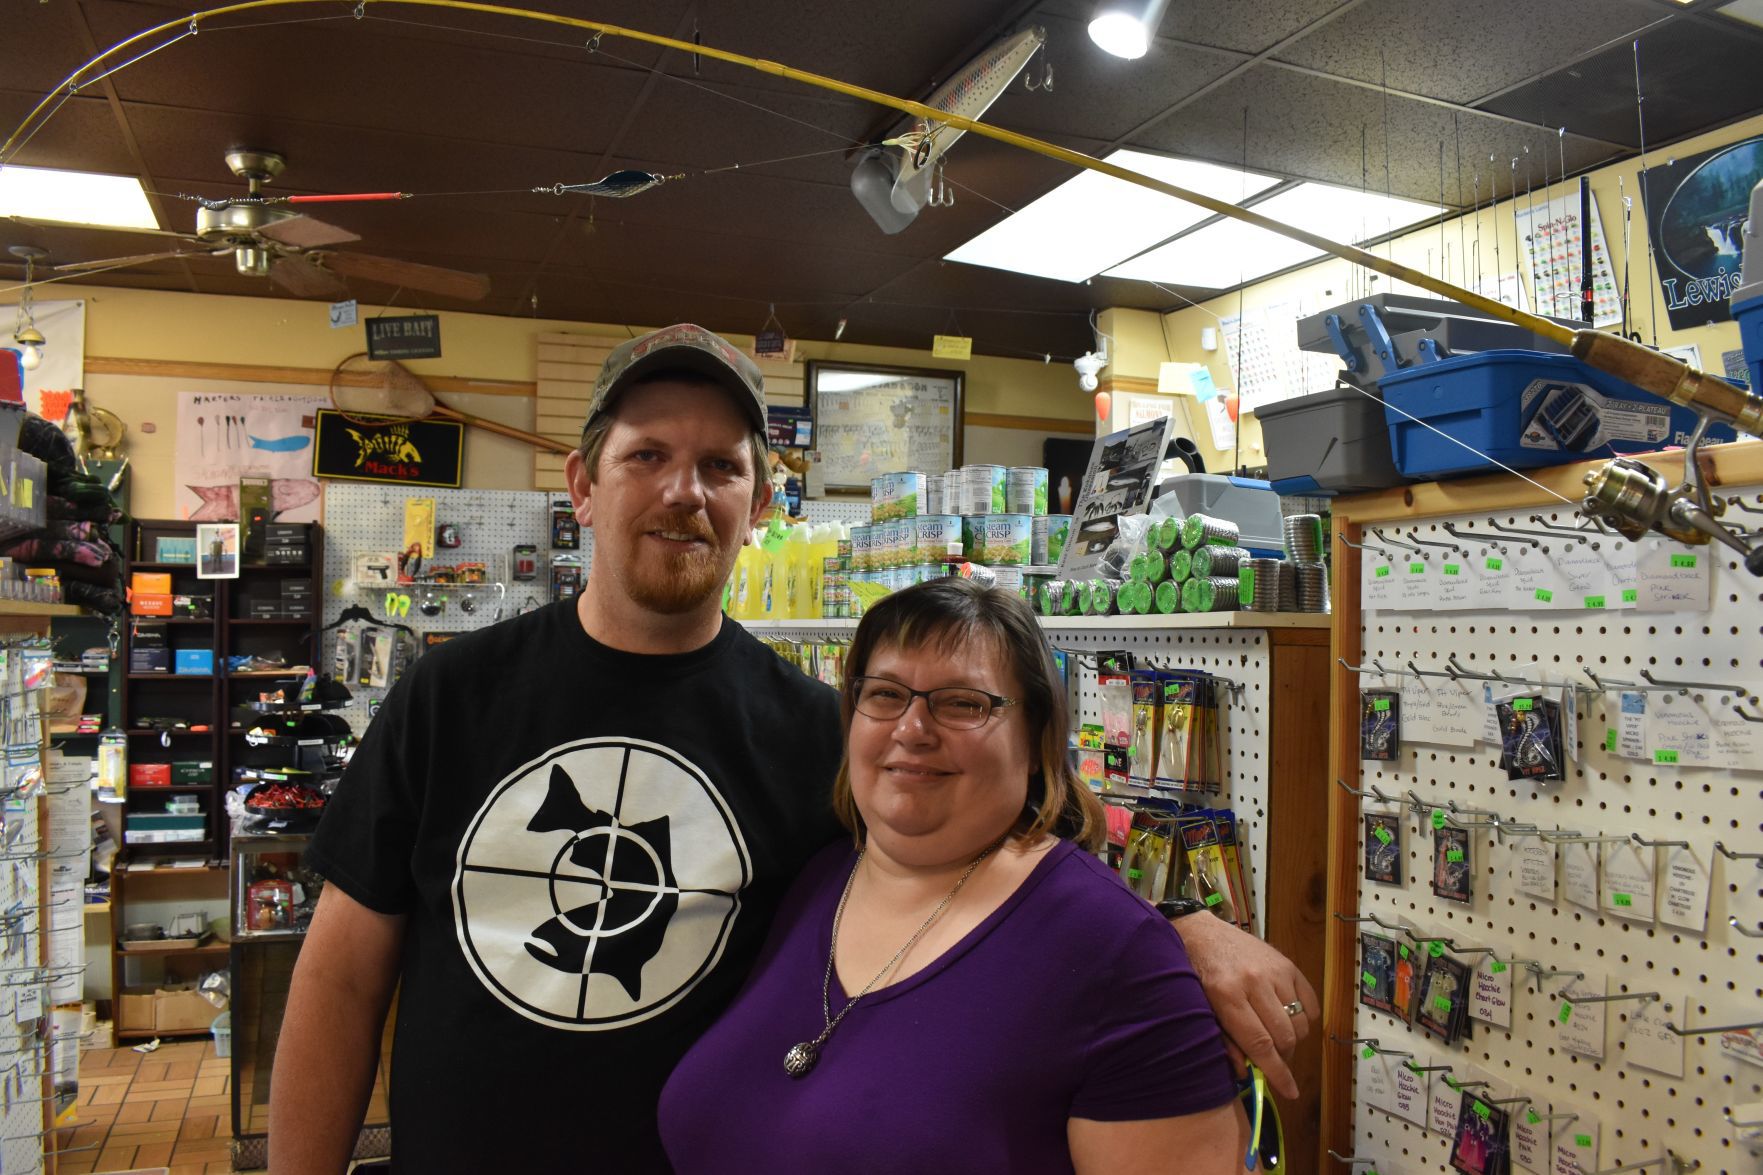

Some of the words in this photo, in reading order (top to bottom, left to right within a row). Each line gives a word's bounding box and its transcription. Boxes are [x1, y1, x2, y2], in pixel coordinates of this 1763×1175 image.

[1537, 214, 1577, 232] Spin-N-Glo
[372, 323, 400, 340] LIVE
[403, 320, 434, 338] BAIT
[1674, 430, 1723, 447] Flabeau
[986, 530, 1011, 539] CRISP
[1477, 970, 1495, 983] Micro
[1479, 981, 1502, 994] Hoochie
[1397, 1069, 1414, 1083] Micro
[1435, 1096, 1453, 1110] Micro
[1516, 1122, 1534, 1136] Micro
[1557, 1144, 1577, 1159] Micro
